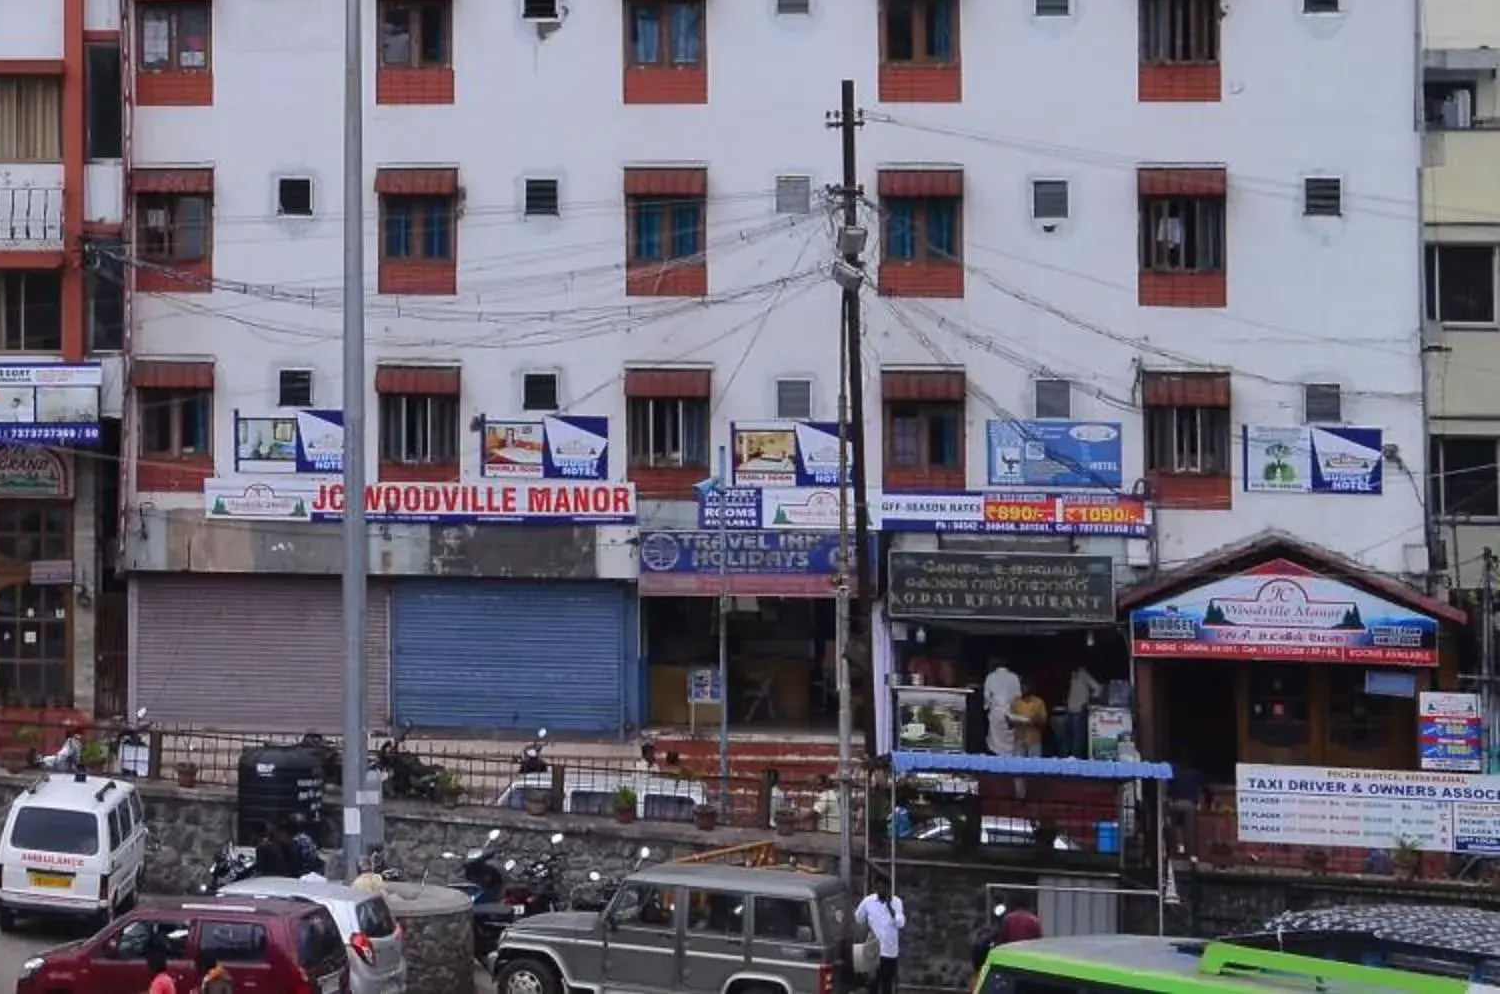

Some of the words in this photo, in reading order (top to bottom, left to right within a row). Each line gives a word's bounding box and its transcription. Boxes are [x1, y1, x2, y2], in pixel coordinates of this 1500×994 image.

[1331, 481, 1373, 491] HOTEL
[312, 483, 345, 511] JC
[363, 485, 517, 512] WOODVILLE
[527, 486, 631, 512] MANOR
[949, 503, 981, 513] RATES
[679, 533, 771, 549] TRAVEL
[692, 551, 810, 567] HOLIDAYS
[964, 593, 1103, 609] RESTAURANT
[1224, 602, 1290, 617] Woodville
[1293, 605, 1343, 619] Manor
[1248, 777, 1284, 791] TAXI
[1288, 779, 1347, 794] DRIVER
[1351, 782, 1364, 795] &
[1367, 784, 1438, 799] OWNERS
[1441, 787, 1500, 802] ASSOC
[21, 853, 85, 867] AMBULANCE
